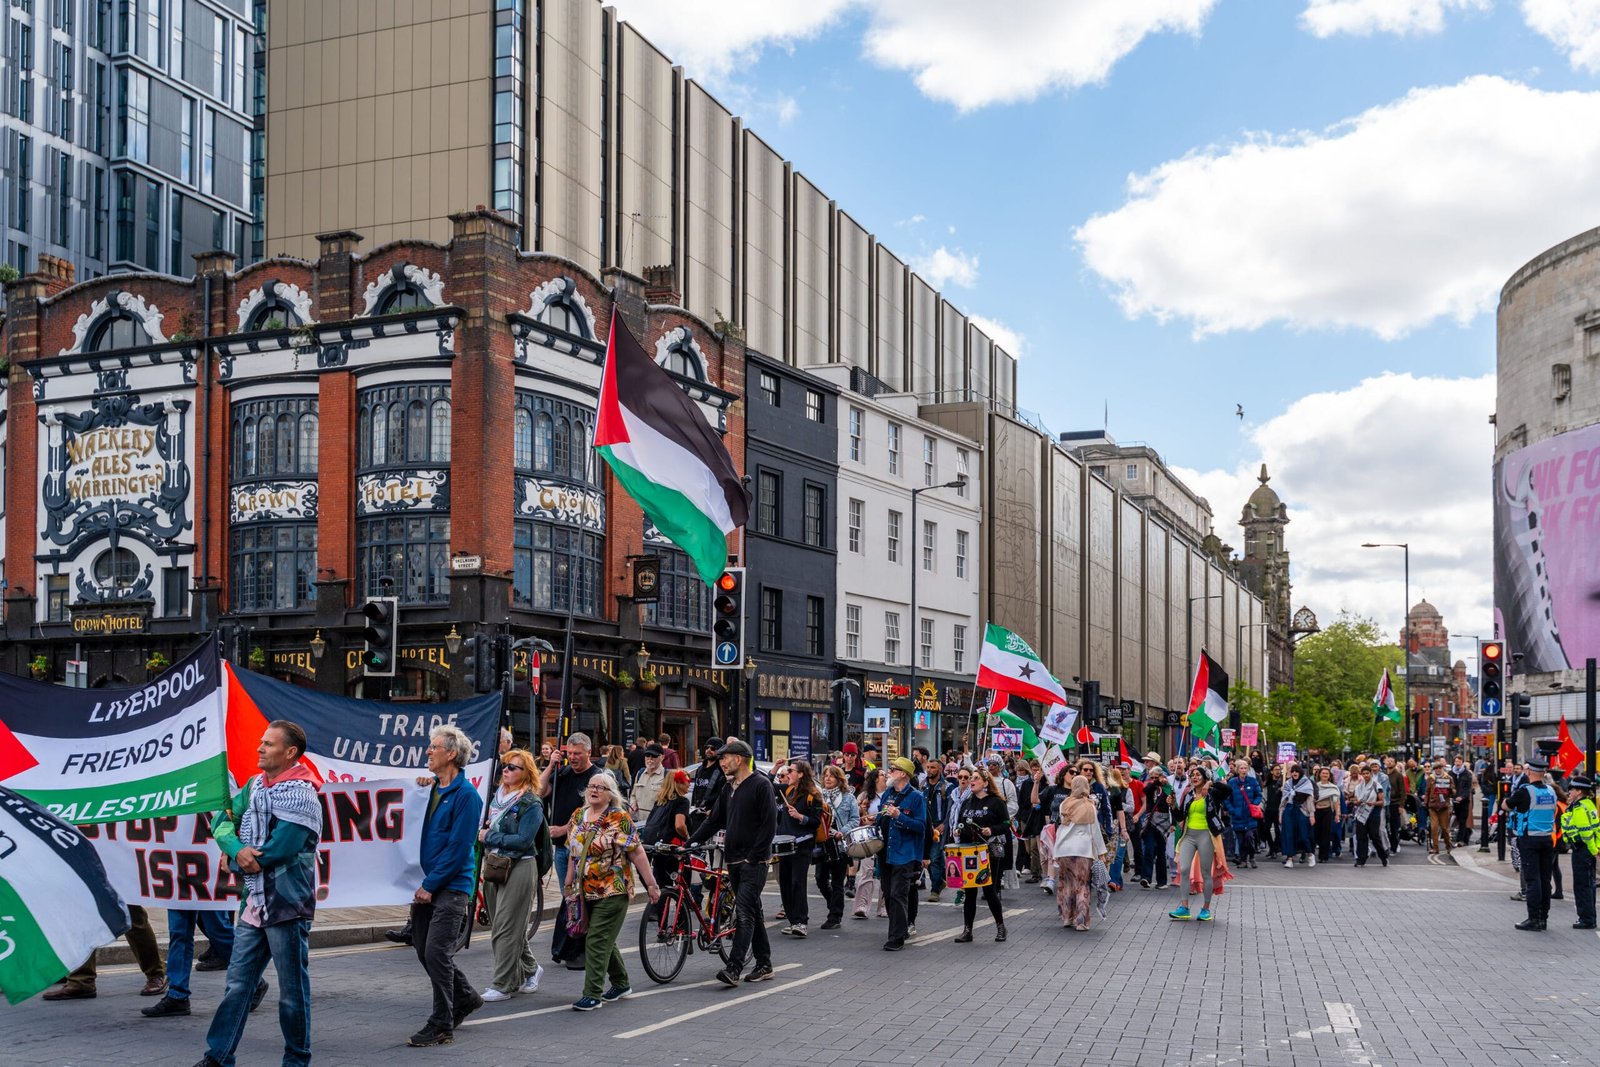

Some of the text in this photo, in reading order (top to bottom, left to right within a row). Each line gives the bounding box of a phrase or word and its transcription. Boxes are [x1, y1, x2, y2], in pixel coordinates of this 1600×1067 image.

[92, 451, 139, 478] ALES
[68, 464, 163, 500] WARRINGTON
[365, 481, 432, 503] HOTEL
[237, 490, 298, 511] CROWN
[74, 616, 143, 631] CROWN HOTEL
[274, 653, 316, 673] HOTEL
[402, 648, 450, 669] HOTEL
[513, 651, 617, 680] CRWN HOTEL
[89, 658, 205, 722] LIVERPOOL
[688, 668, 728, 689] HOTEL
[758, 674, 834, 702] BACKSTAGE
[914, 699, 941, 711] SOLARSUN
[379, 713, 458, 737] TRADE
[61, 717, 207, 775] FRIENDS OF
[333, 737, 481, 767] UNIONS
[46, 783, 198, 822] PALESTINE
[135, 848, 331, 902] ISRA!
